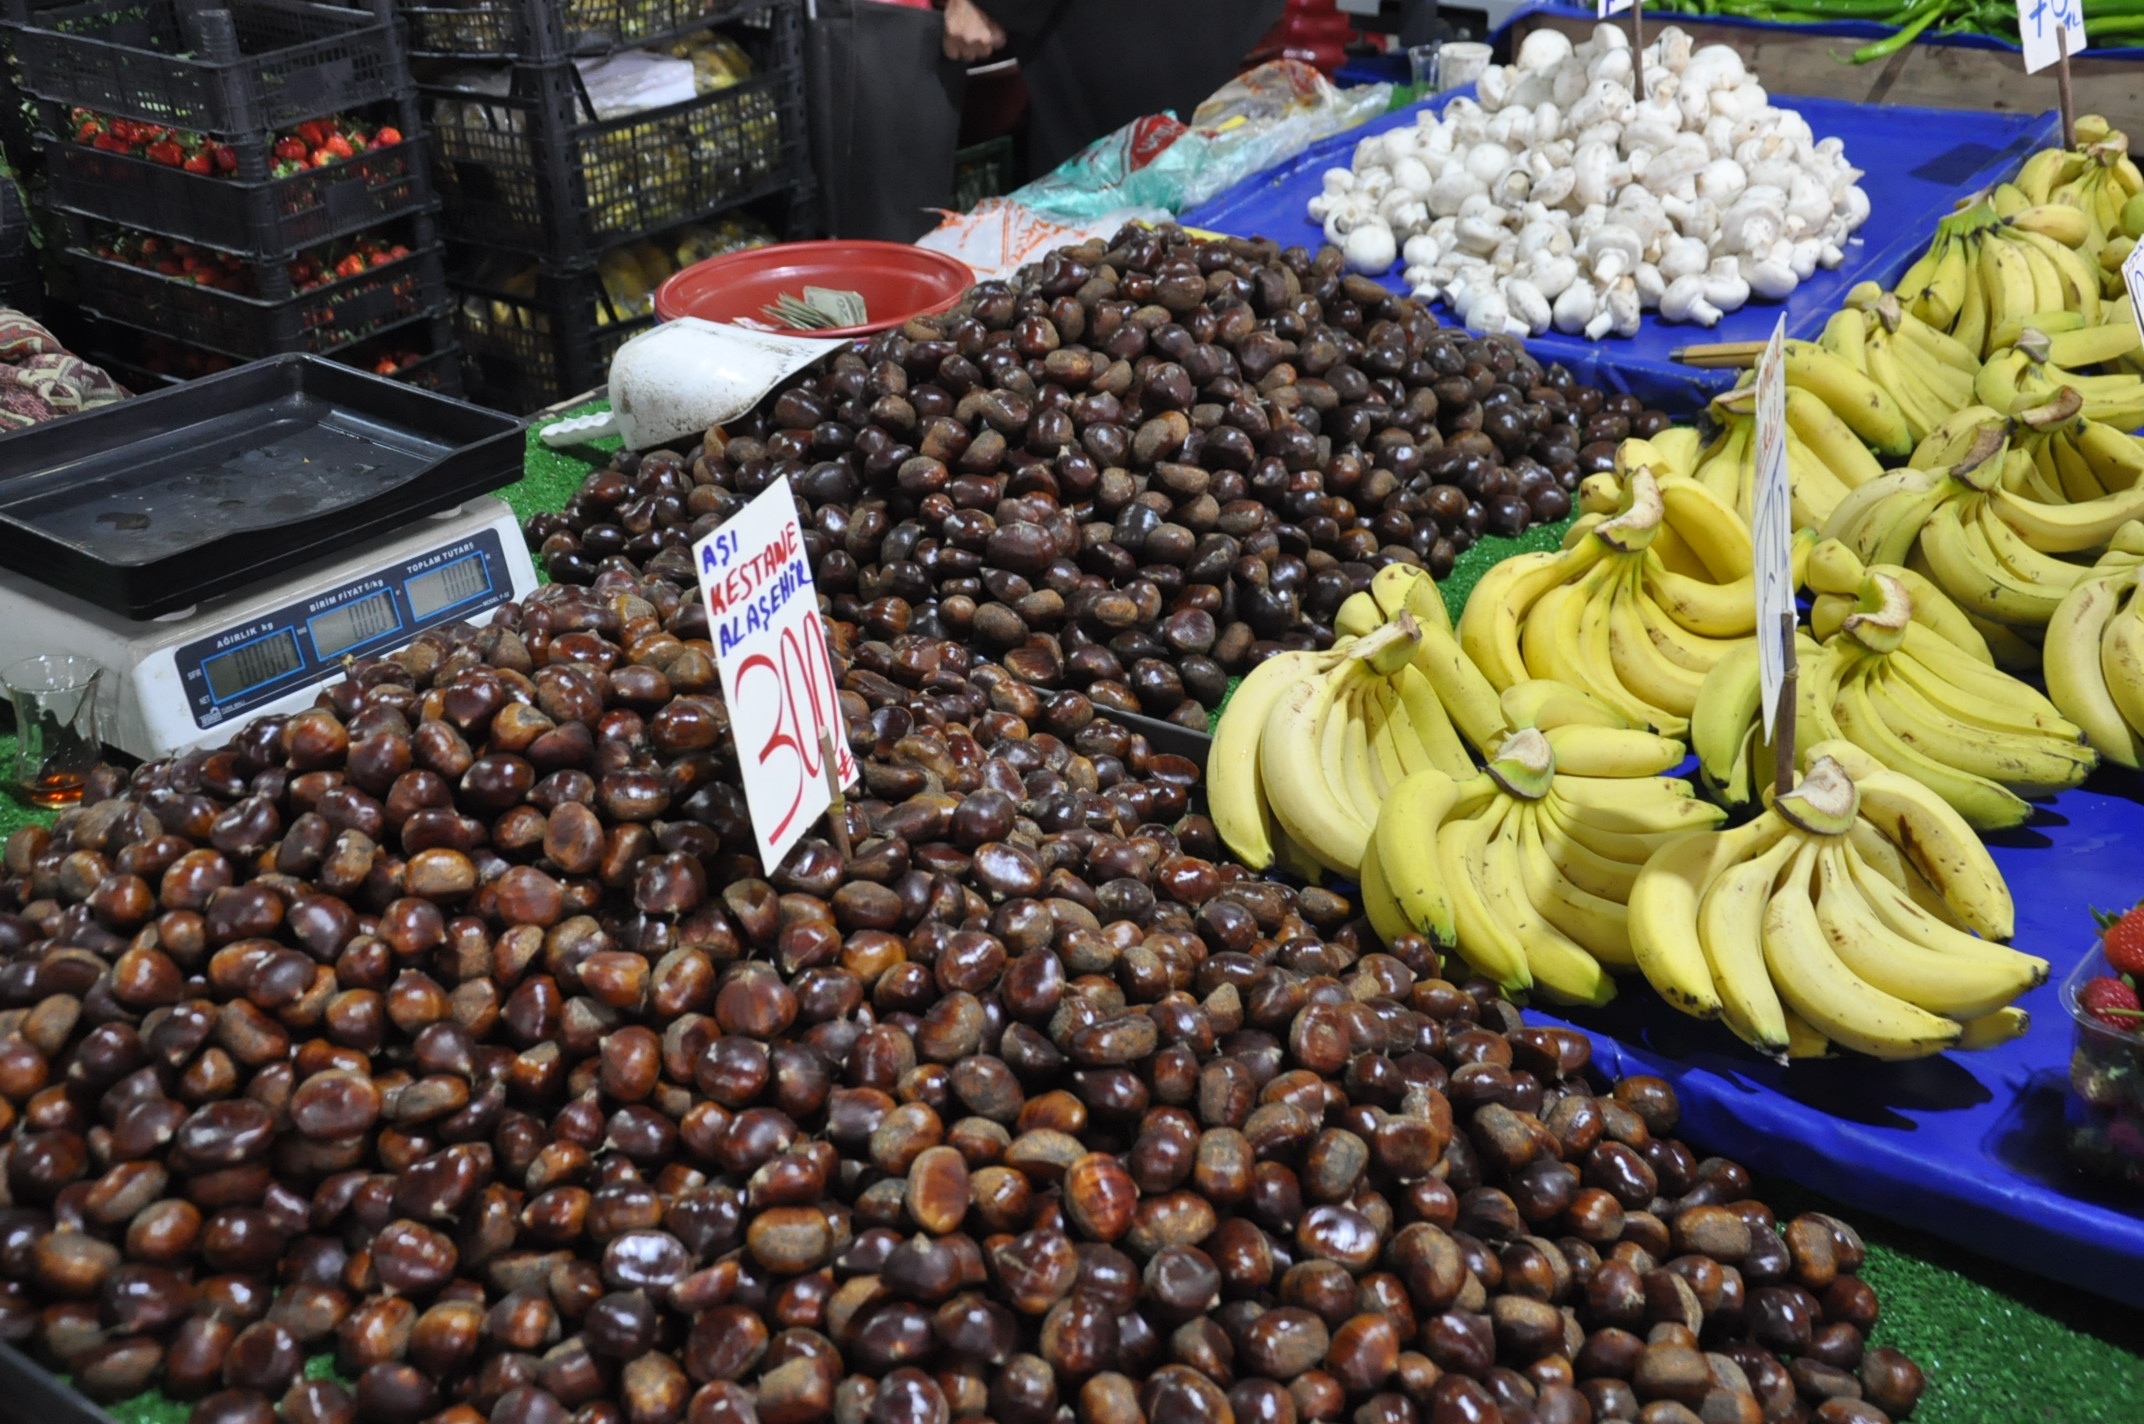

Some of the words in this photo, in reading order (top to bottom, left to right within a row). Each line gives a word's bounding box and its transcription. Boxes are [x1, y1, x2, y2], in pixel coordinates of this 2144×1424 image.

[406, 555, 441, 574] TOPLAM
[702, 529, 738, 575] AŞI
[710, 521, 798, 616] KESTANE
[309, 596, 337, 613] BİRİM
[338, 585, 363, 602] FİYAT
[719, 559, 813, 658] ALAŞEHİR
[216, 627, 258, 649] AĞIRLIK
[261, 622, 274, 632] kg
